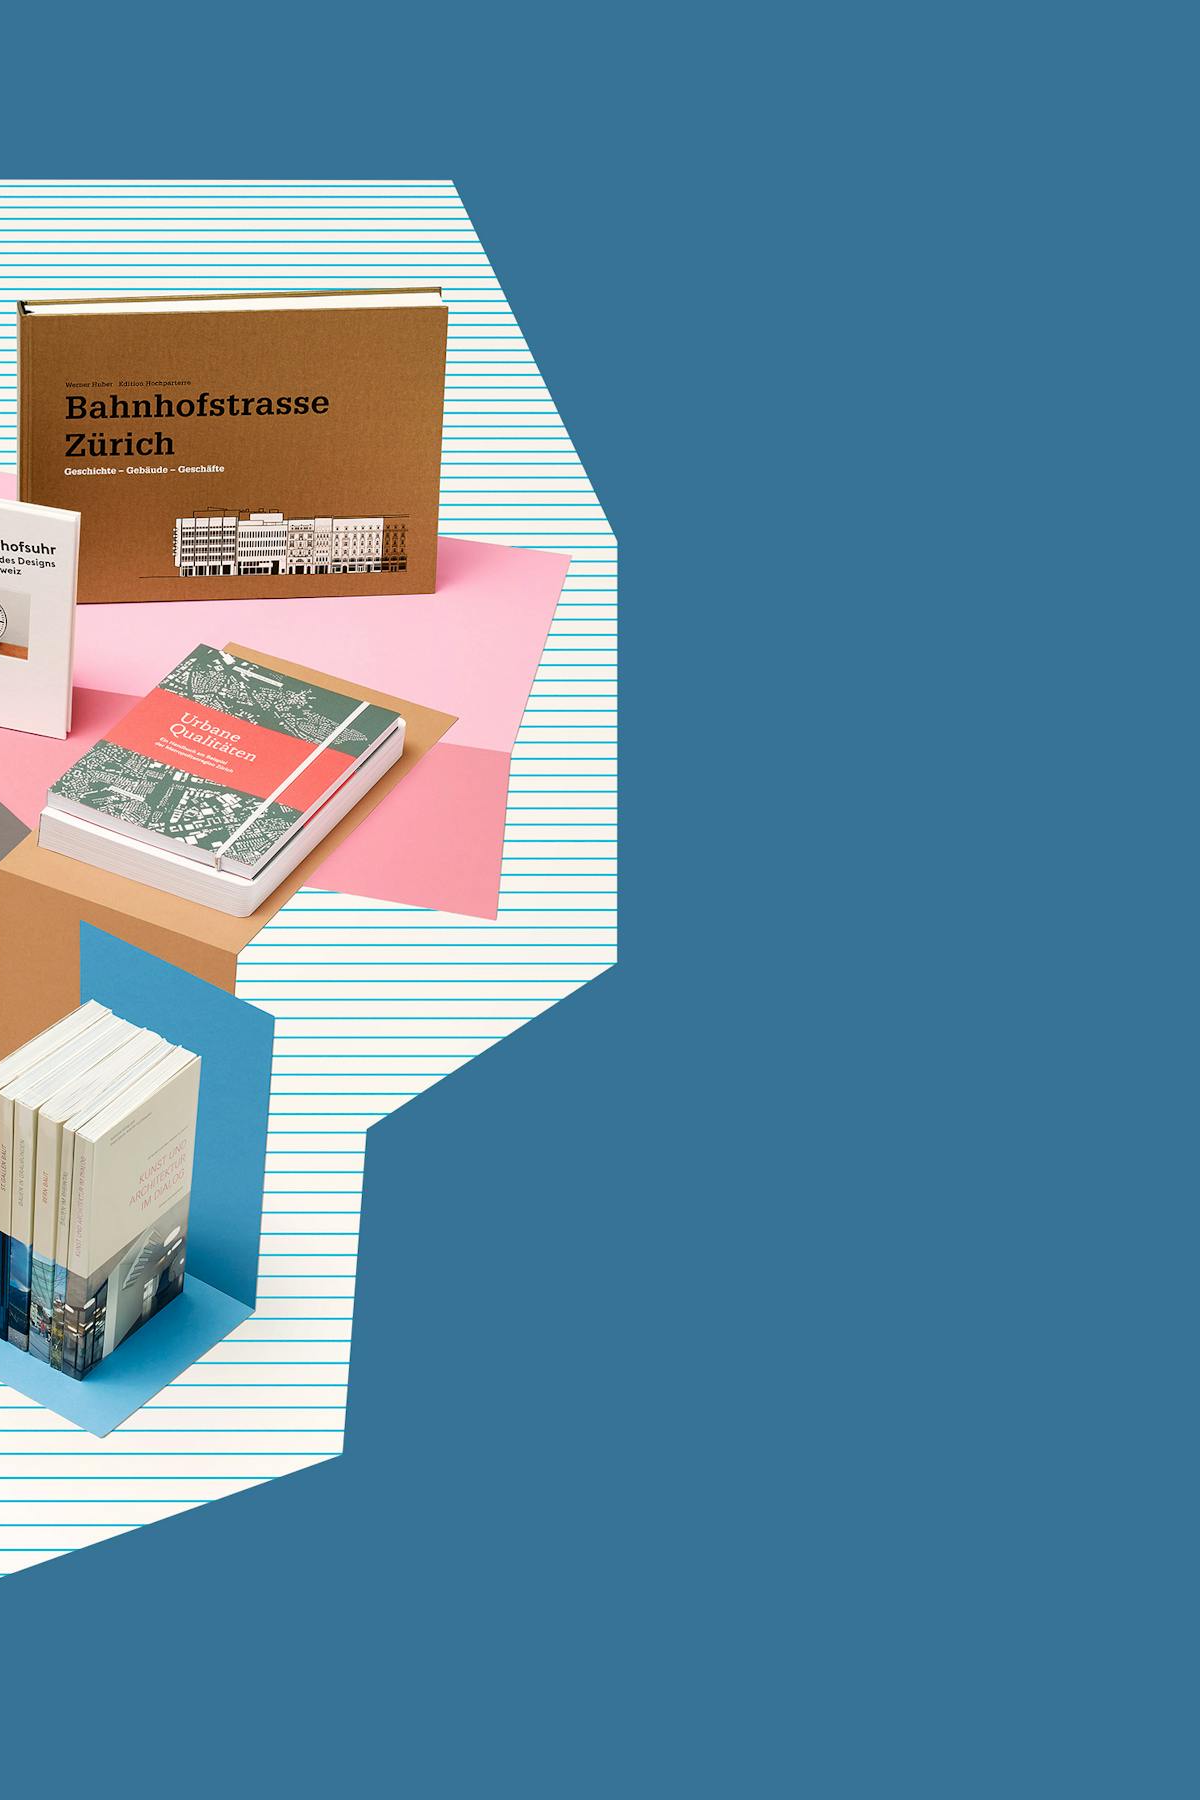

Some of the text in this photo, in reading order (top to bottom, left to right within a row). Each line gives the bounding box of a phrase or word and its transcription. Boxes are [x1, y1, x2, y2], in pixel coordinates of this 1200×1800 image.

[65, 392, 329, 420] Bahnhofstrasse
[64, 432, 175, 457] Zürich
[64, 467, 117, 476] Geschichte
[126, 465, 168, 475] Gebäude
[178, 464, 225, 474] Geschäfte
[0, 556, 16, 565] des
[18, 557, 56, 569] Designs
[169, 723, 257, 762] Qualitäten
[180, 712, 241, 743] Urbane
[139, 1155, 167, 1184] KUNST
[168, 1138, 188, 1161] UND
[128, 1153, 187, 1207] ARCHITEKTUR
[141, 1195, 153, 1212] IM
[154, 1168, 185, 1202] DIALOG
